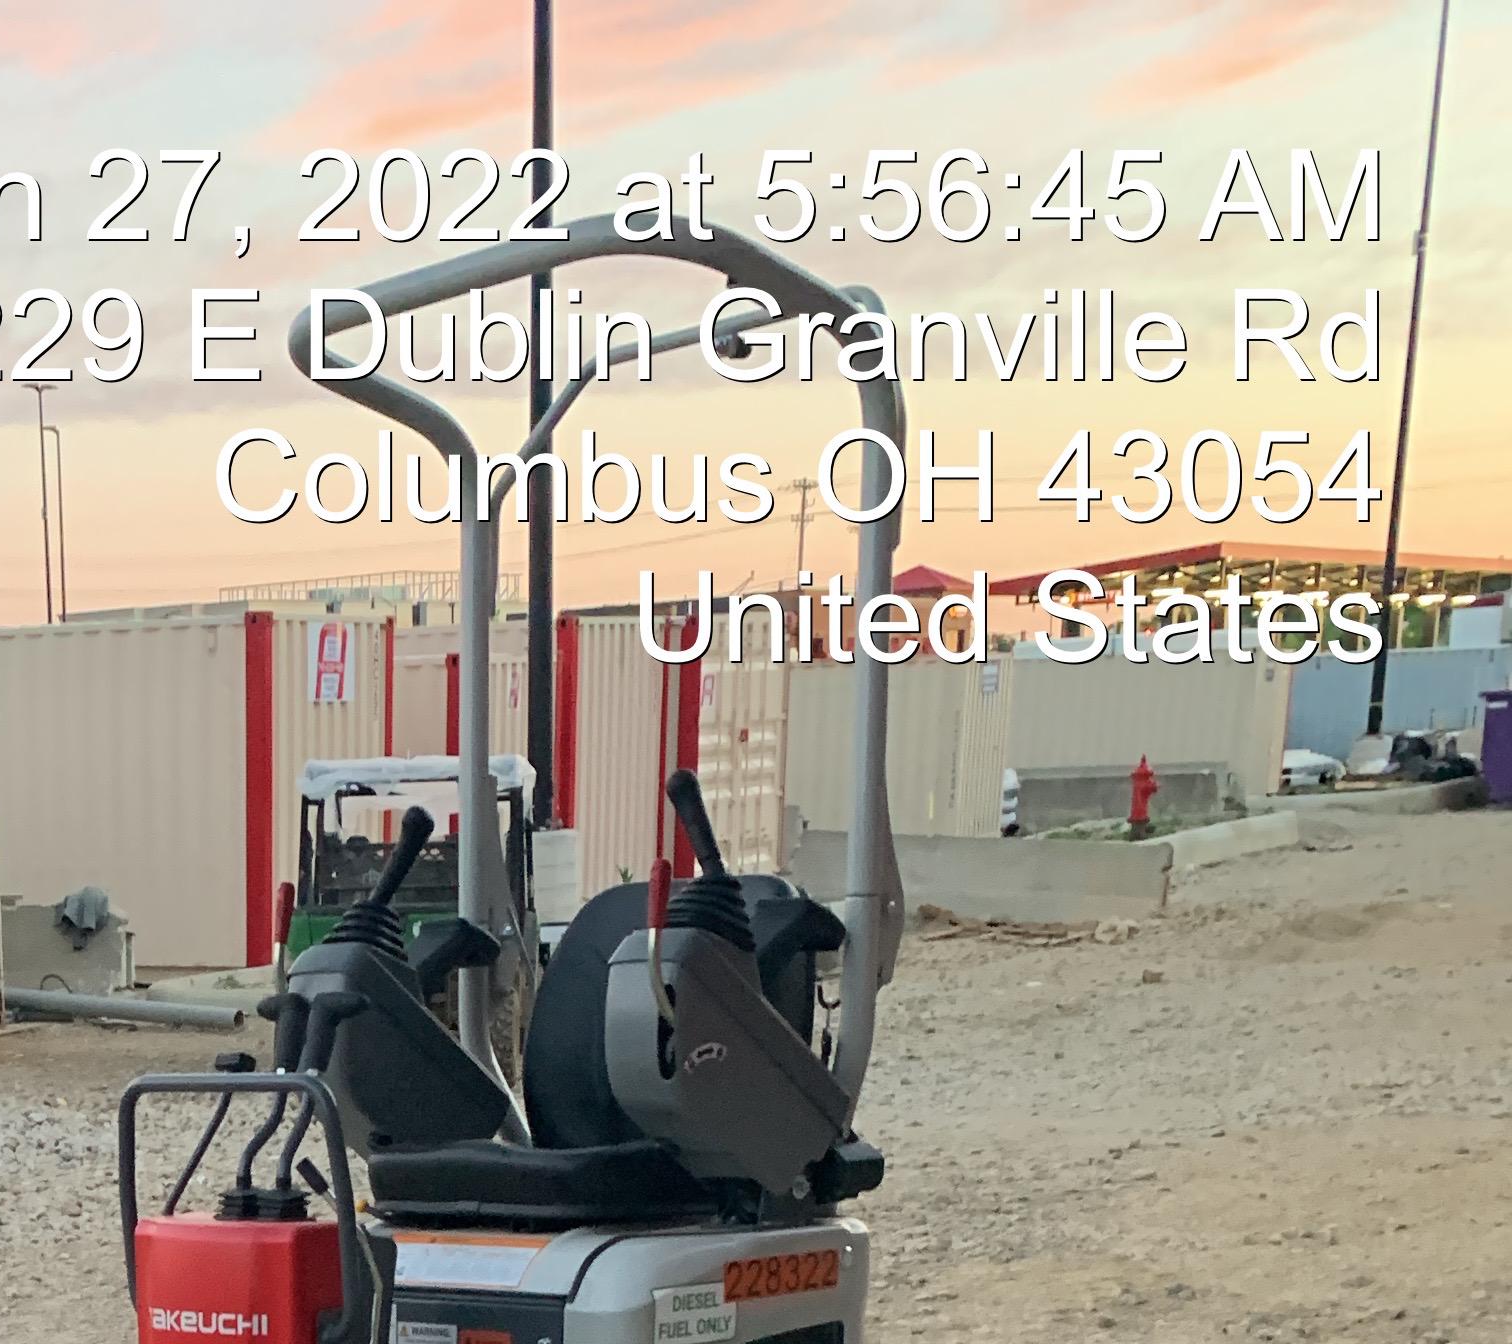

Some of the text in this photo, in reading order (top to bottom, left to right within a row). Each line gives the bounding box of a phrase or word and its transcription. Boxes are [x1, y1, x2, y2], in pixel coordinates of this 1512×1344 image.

[727, 1251, 838, 1301] 228322
[672, 1292, 719, 1312] DIESEL
[149, 1306, 268, 1336] AKEUCHI
[659, 1315, 731, 1339] FUEL ONLY
